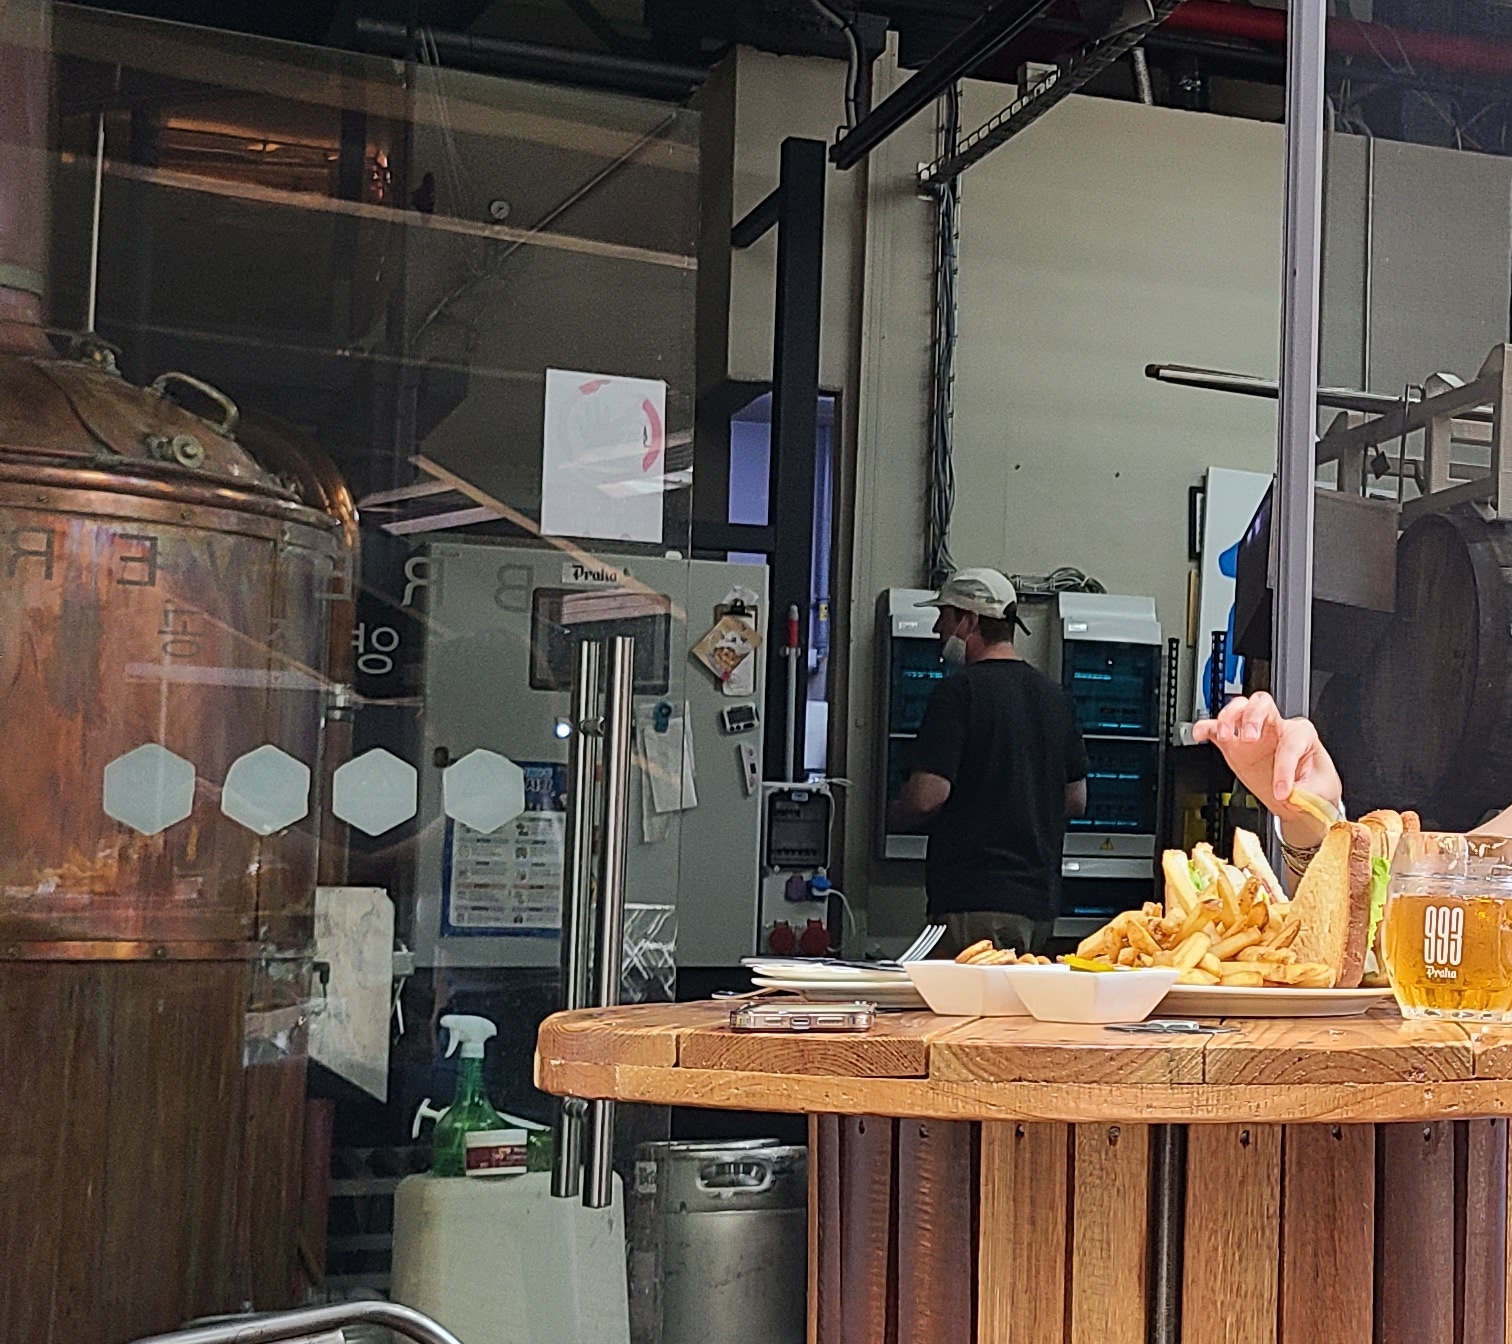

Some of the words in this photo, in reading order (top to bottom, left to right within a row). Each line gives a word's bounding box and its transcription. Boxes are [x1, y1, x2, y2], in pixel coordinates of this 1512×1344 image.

[572, 564, 617, 583] Praha
[1424, 906, 1464, 966] 993
[1425, 965, 1457, 979] Praha
